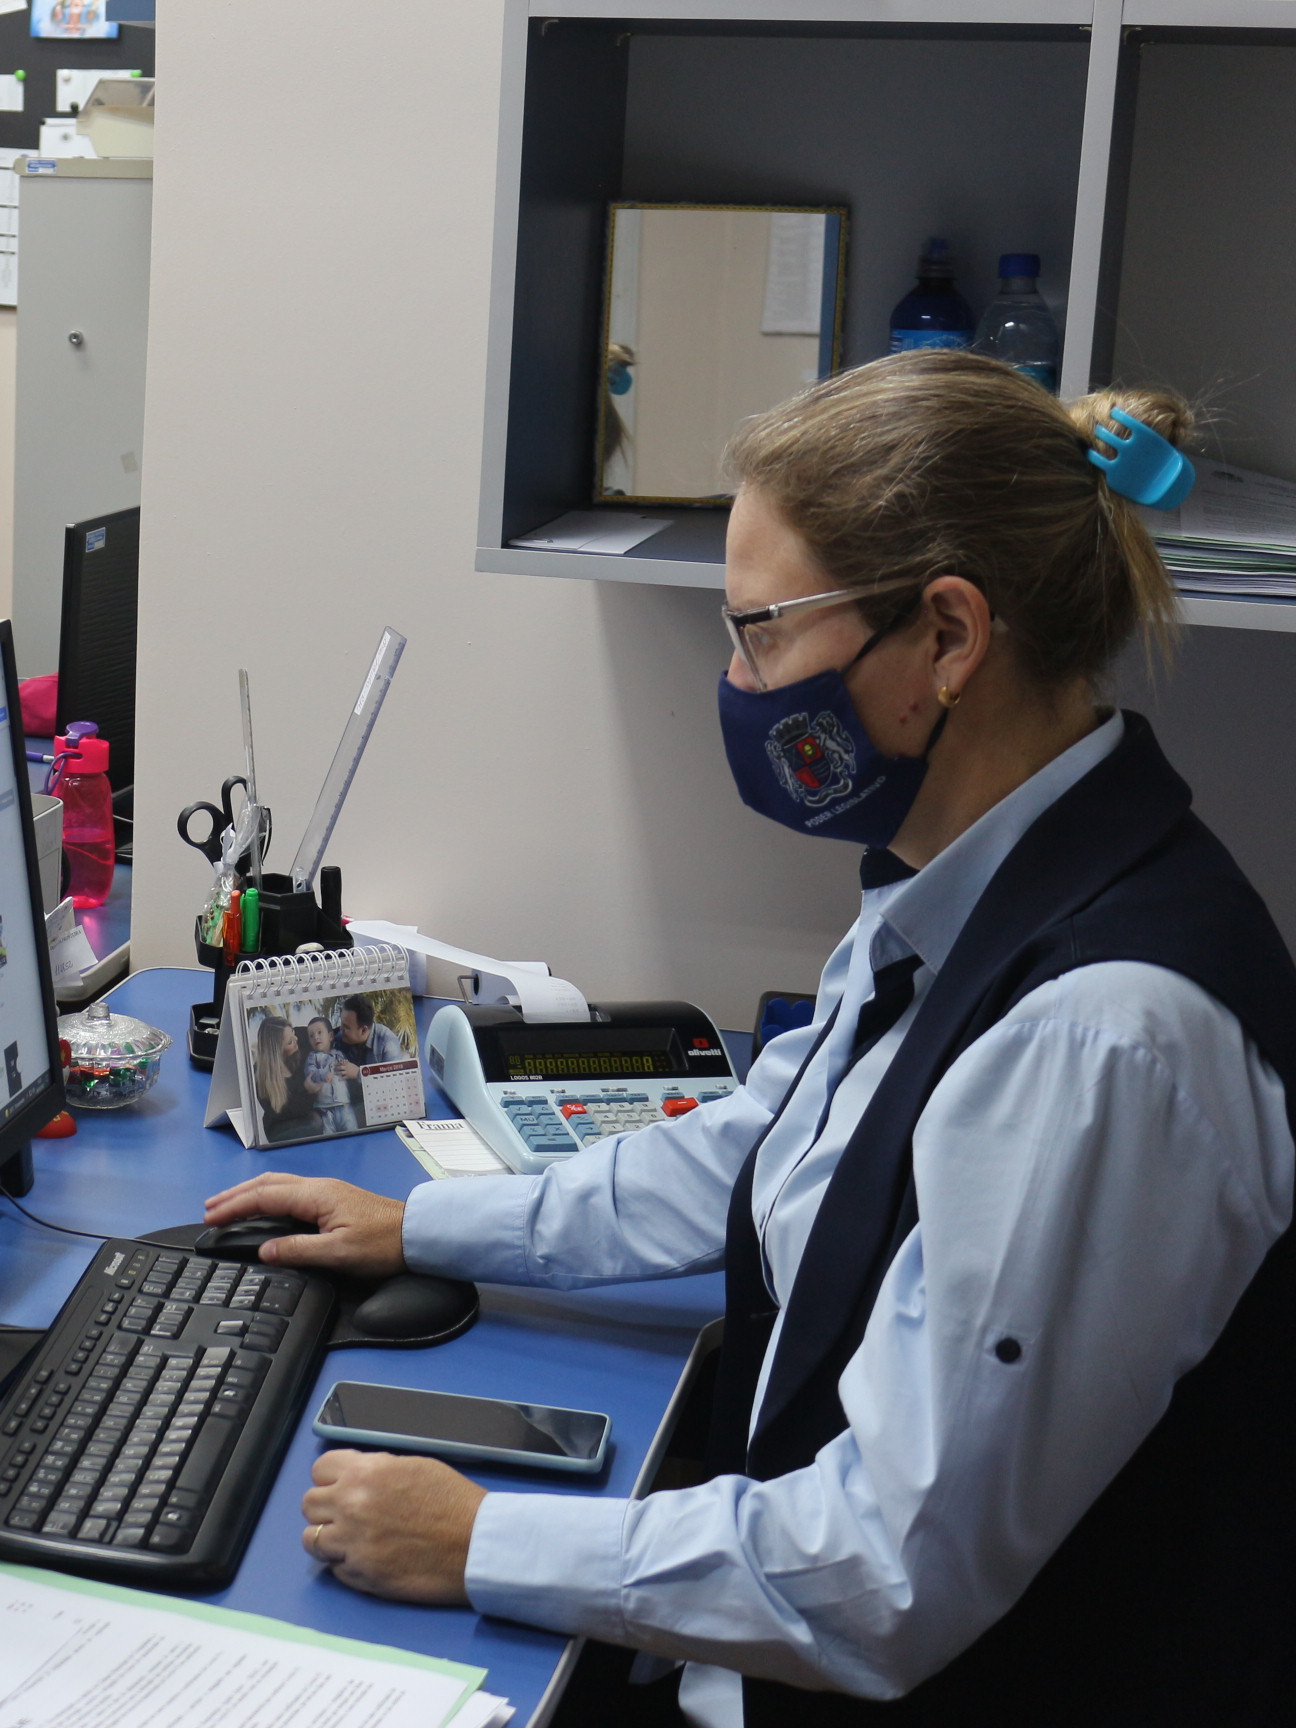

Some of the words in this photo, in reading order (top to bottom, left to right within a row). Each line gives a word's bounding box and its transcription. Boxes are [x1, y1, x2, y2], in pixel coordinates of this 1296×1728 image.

[804, 811, 834, 828] PODER
[687, 1048, 722, 1056] olivetti
[416, 1121, 464, 1131] Frama
